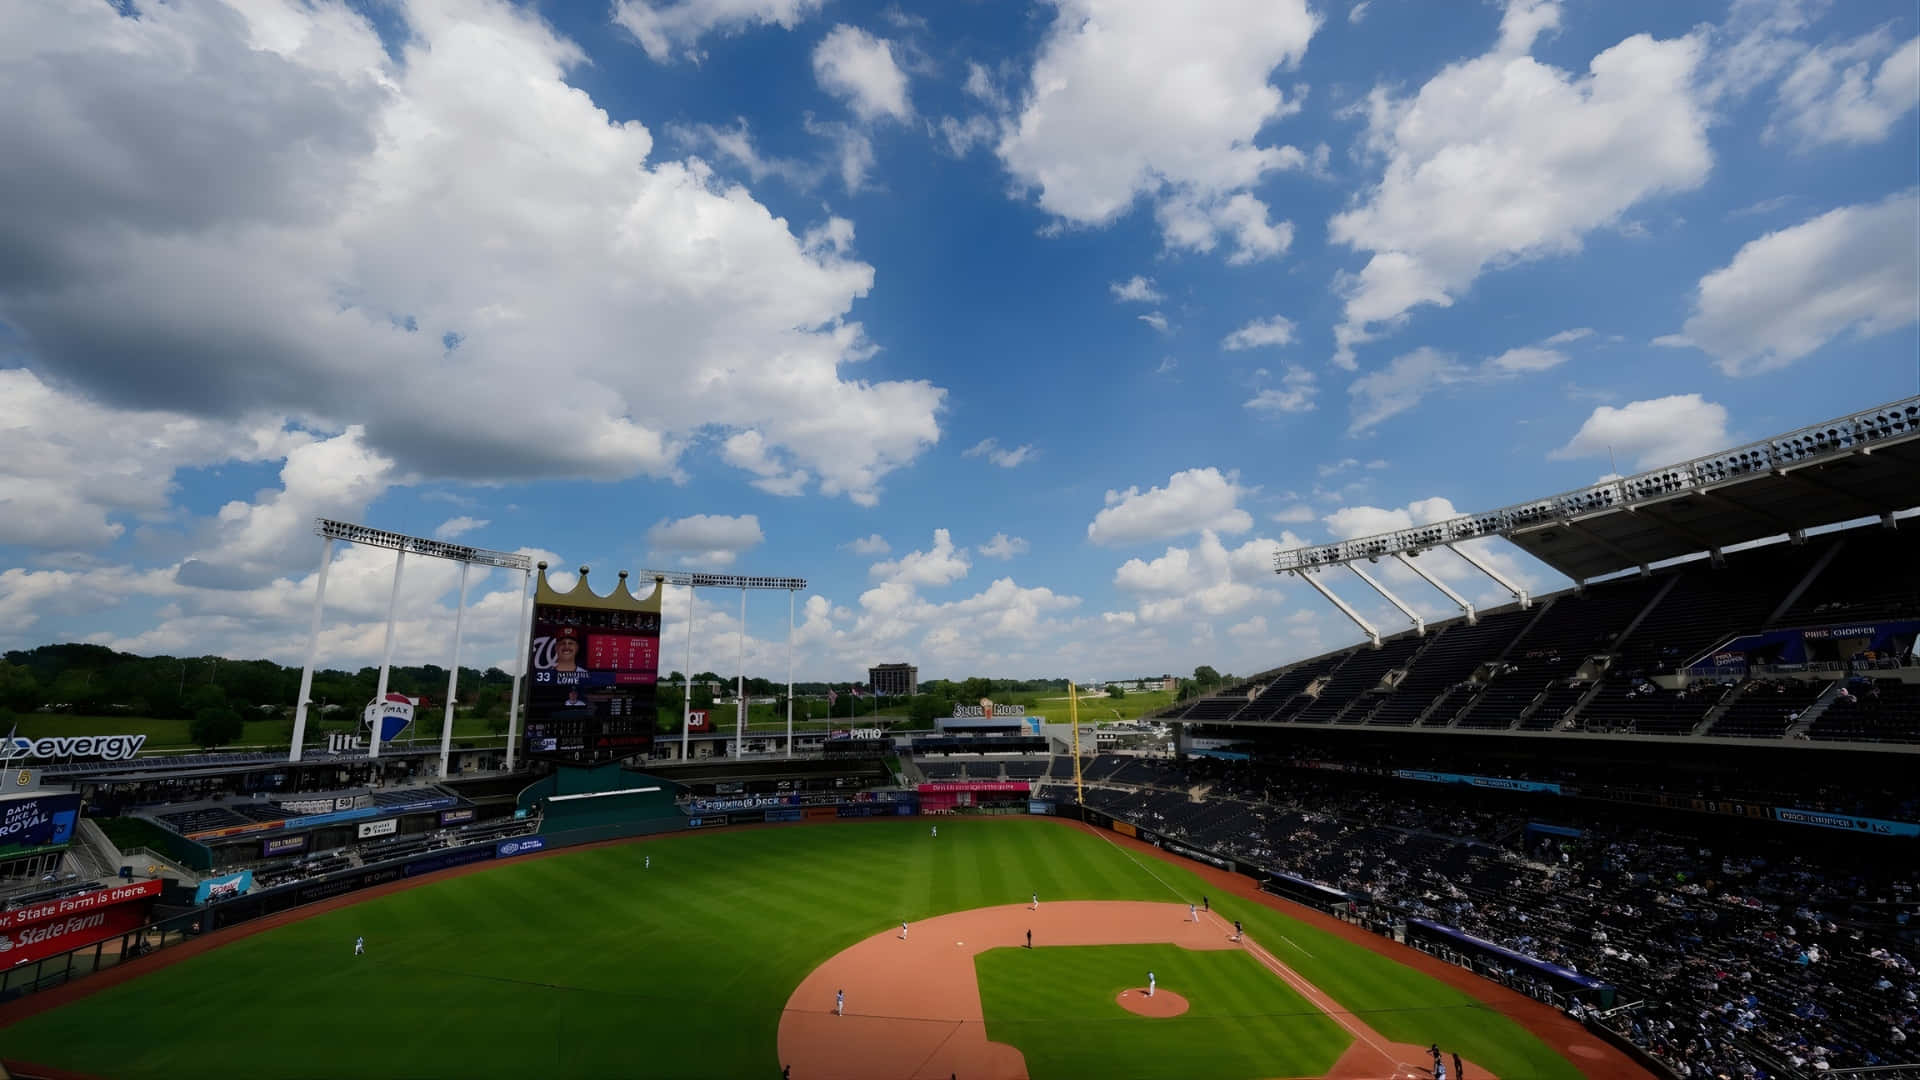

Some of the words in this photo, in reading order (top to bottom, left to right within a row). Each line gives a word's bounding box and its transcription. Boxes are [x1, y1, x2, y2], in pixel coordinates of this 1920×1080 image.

[536, 672, 551, 682] 33
[953, 703, 982, 717] BLUE
[993, 703, 1025, 715] MOON
[689, 712, 706, 726] QT
[850, 728, 882, 740] PATIO
[35, 734, 147, 760] evergy
[5, 808, 29, 824] LIKE
[30, 808, 41, 817] A
[0, 812, 49, 837] ROYAL
[16, 905, 56, 922] State
[59, 896, 94, 912] Farm
[97, 892, 108, 904] is
[111, 885, 147, 900] there.
